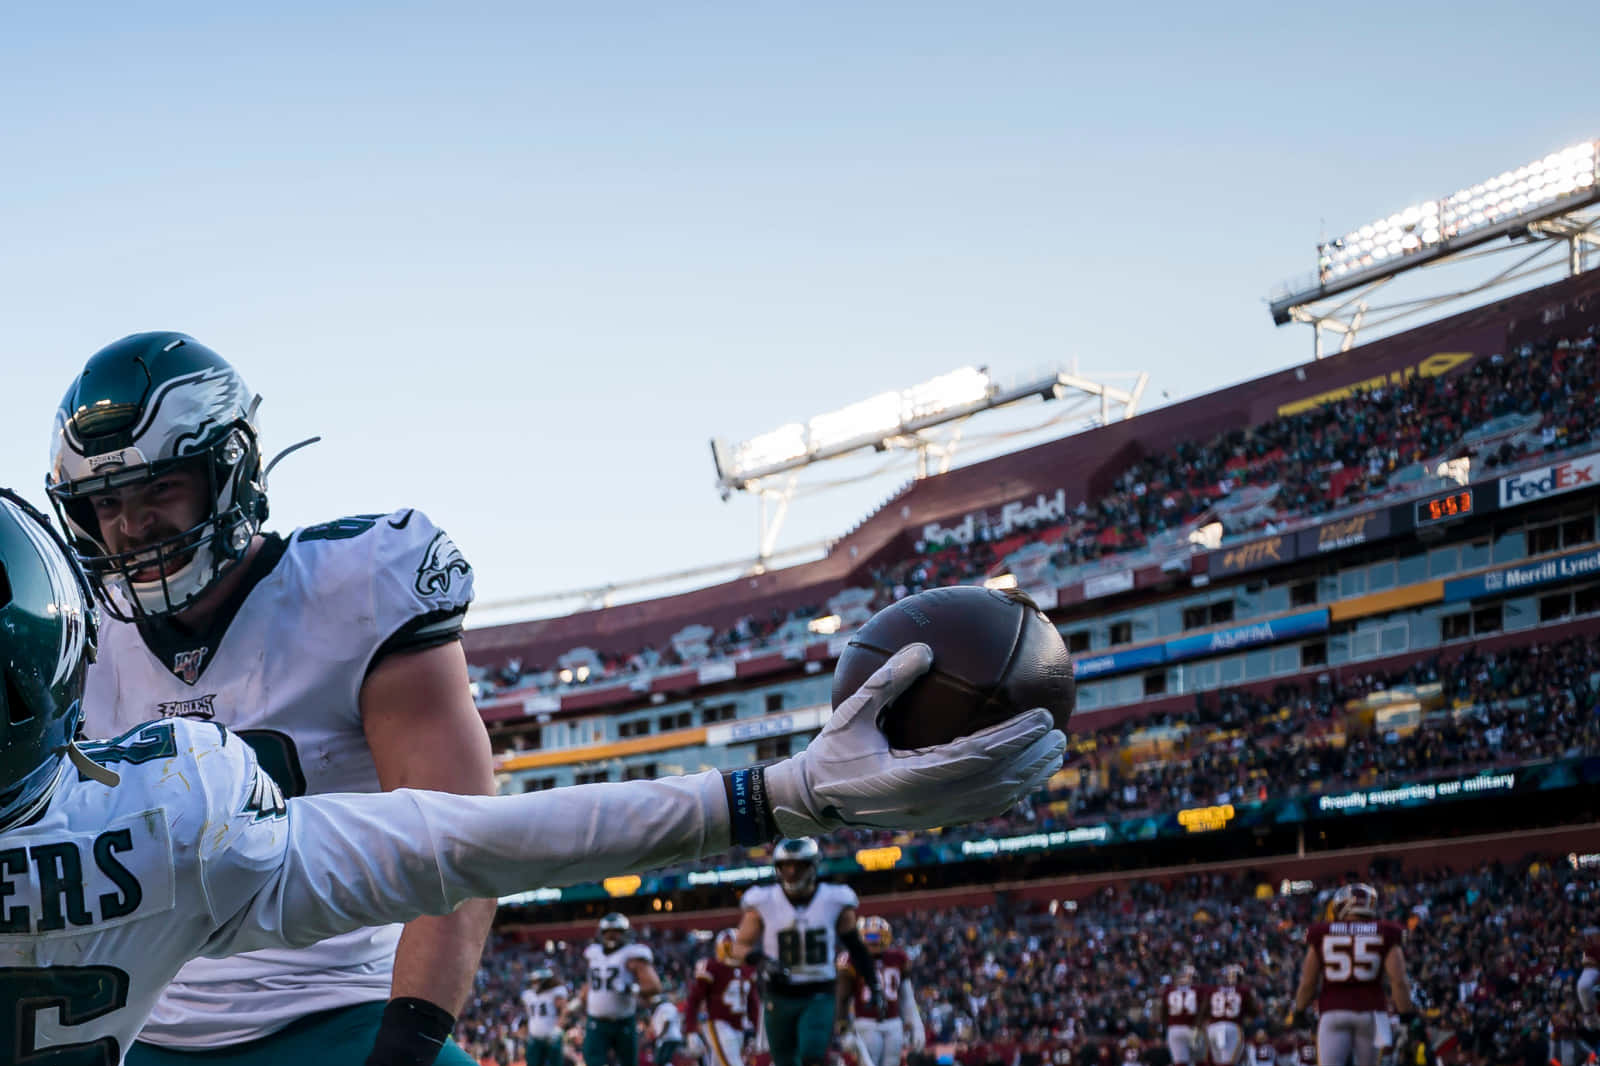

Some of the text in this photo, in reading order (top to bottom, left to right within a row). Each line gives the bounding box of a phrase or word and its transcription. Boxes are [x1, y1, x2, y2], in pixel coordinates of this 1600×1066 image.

[1505, 462, 1594, 502] FedEx
[1506, 561, 1556, 588] Merrill
[158, 694, 217, 719] EAGLES
[1462, 773, 1515, 792] military
[1322, 935, 1384, 982] 55
[590, 967, 621, 991] 62
